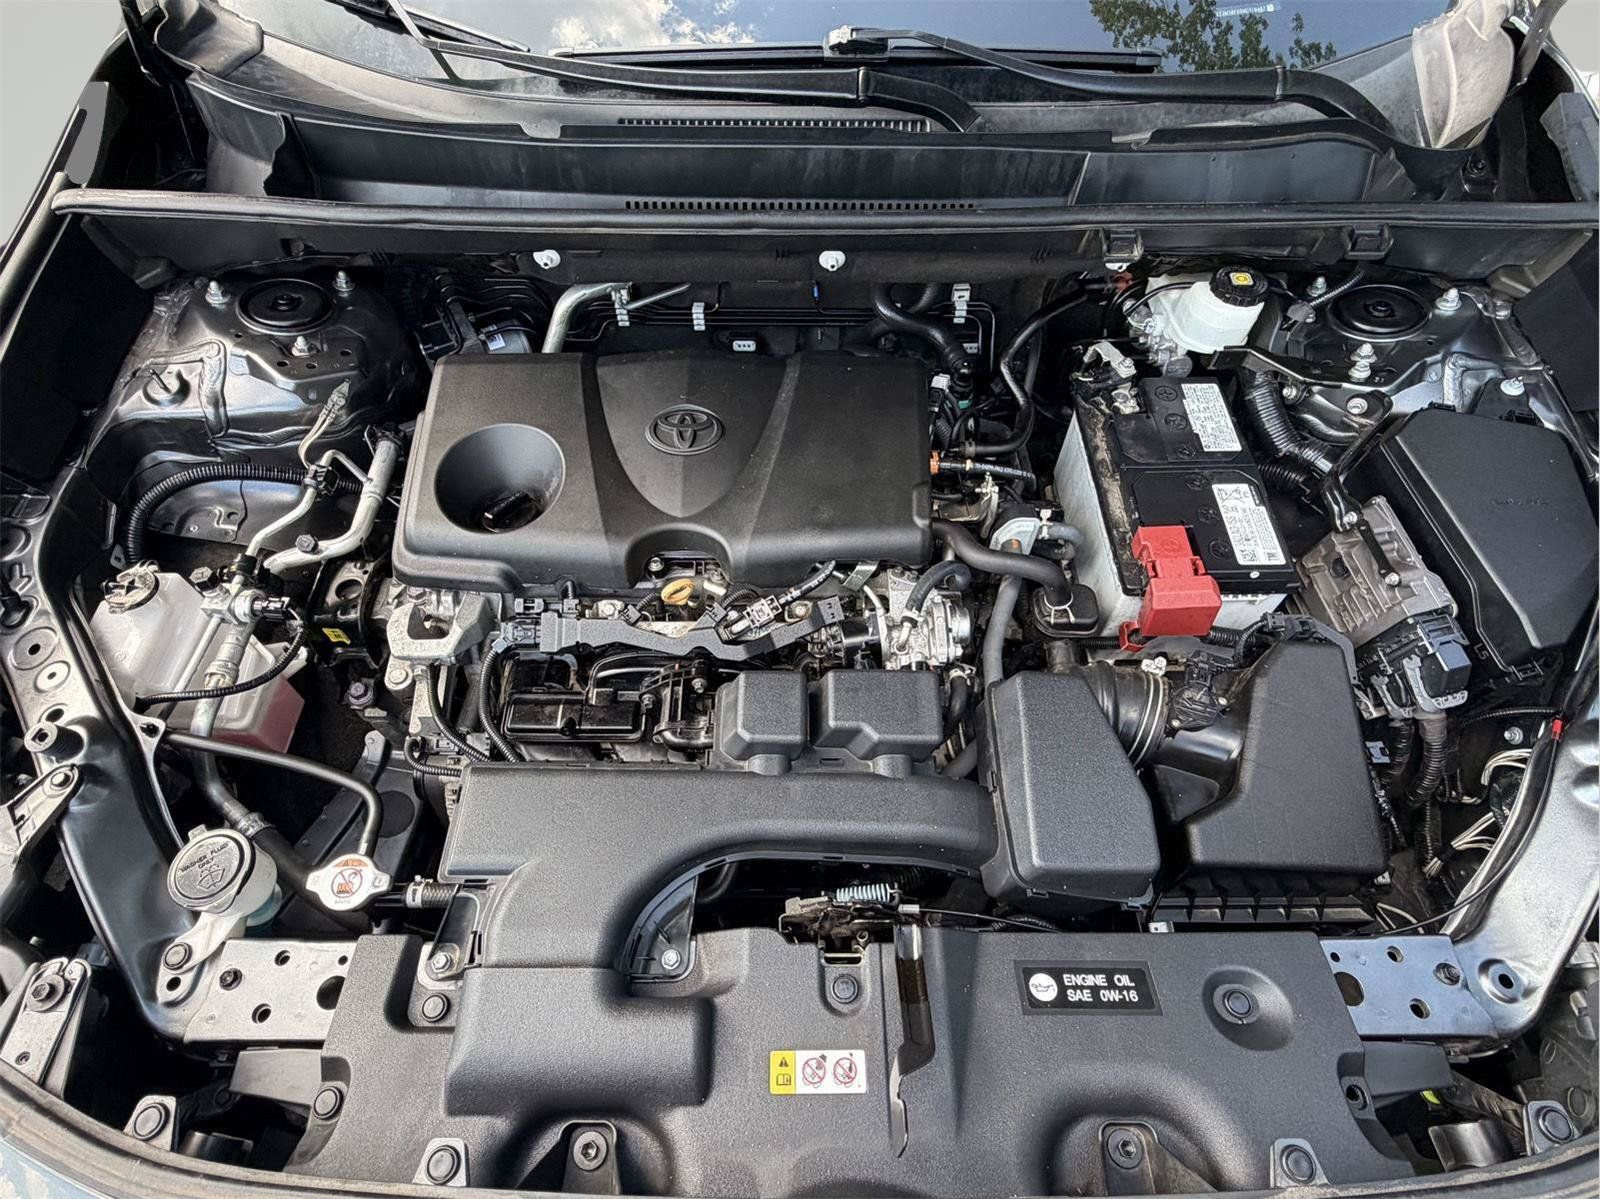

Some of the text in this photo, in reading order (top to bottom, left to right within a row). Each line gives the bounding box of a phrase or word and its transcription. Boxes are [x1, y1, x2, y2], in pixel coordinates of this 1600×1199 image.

[180, 842, 229, 872] WASHER FLUID
[1062, 974, 1136, 987] ENGINE OIL
[1066, 989, 1139, 1002] SAE 0W-16
